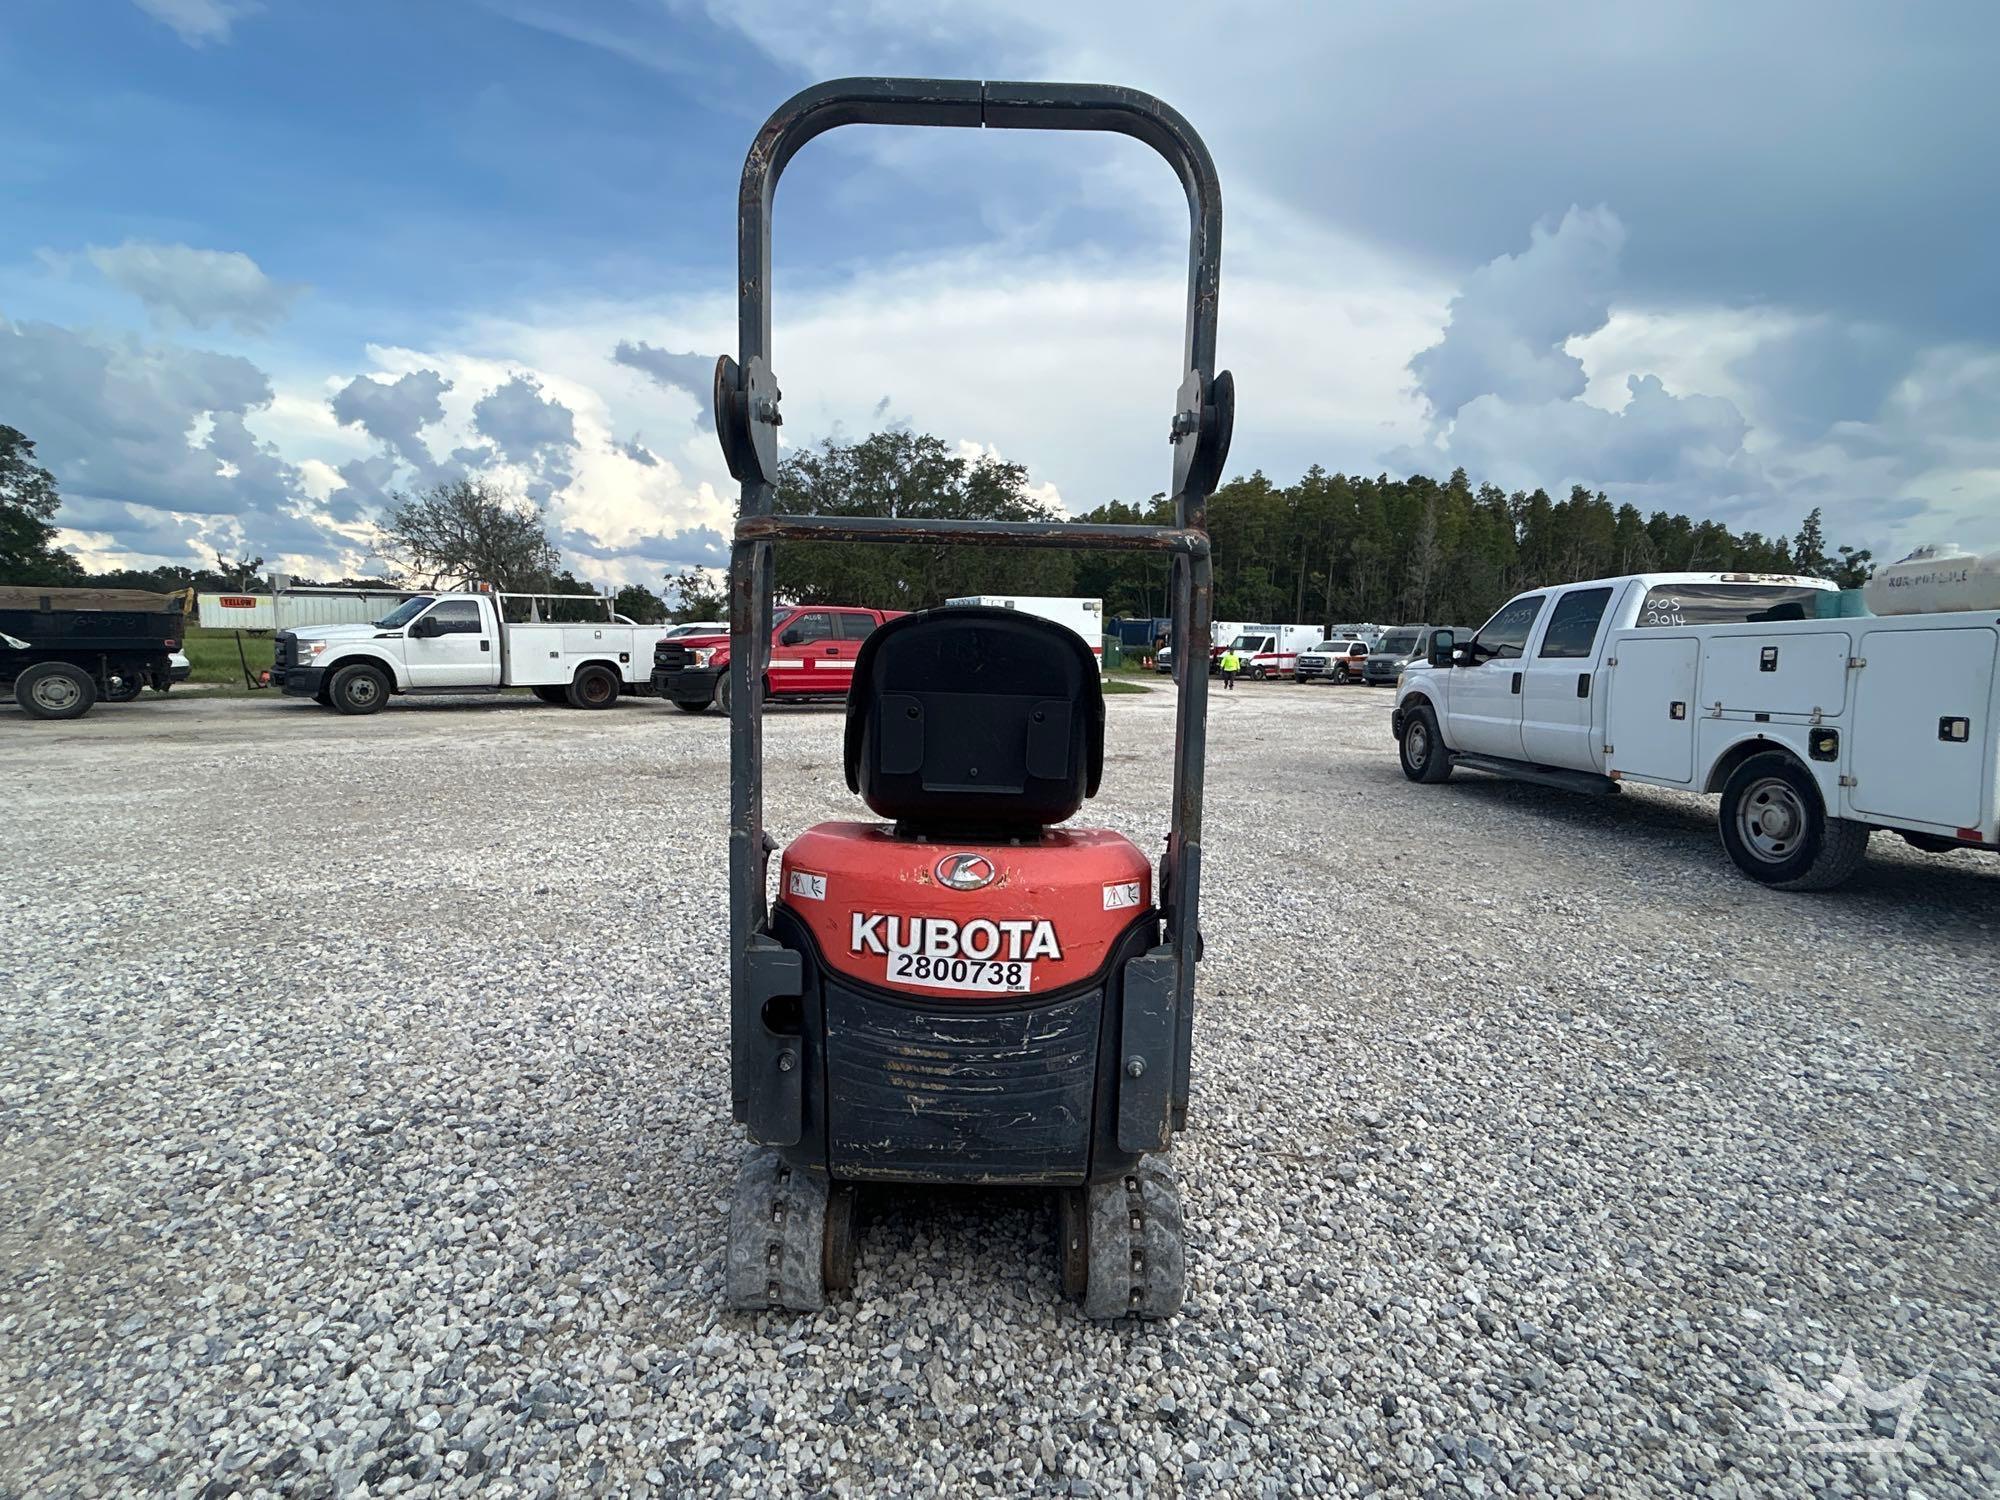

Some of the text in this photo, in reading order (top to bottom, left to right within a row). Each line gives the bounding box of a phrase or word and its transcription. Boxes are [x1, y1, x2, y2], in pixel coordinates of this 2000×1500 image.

[1647, 611, 1687, 627] 2014
[851, 911, 1062, 961] KUBOTA
[896, 952, 1022, 986] 2800738
